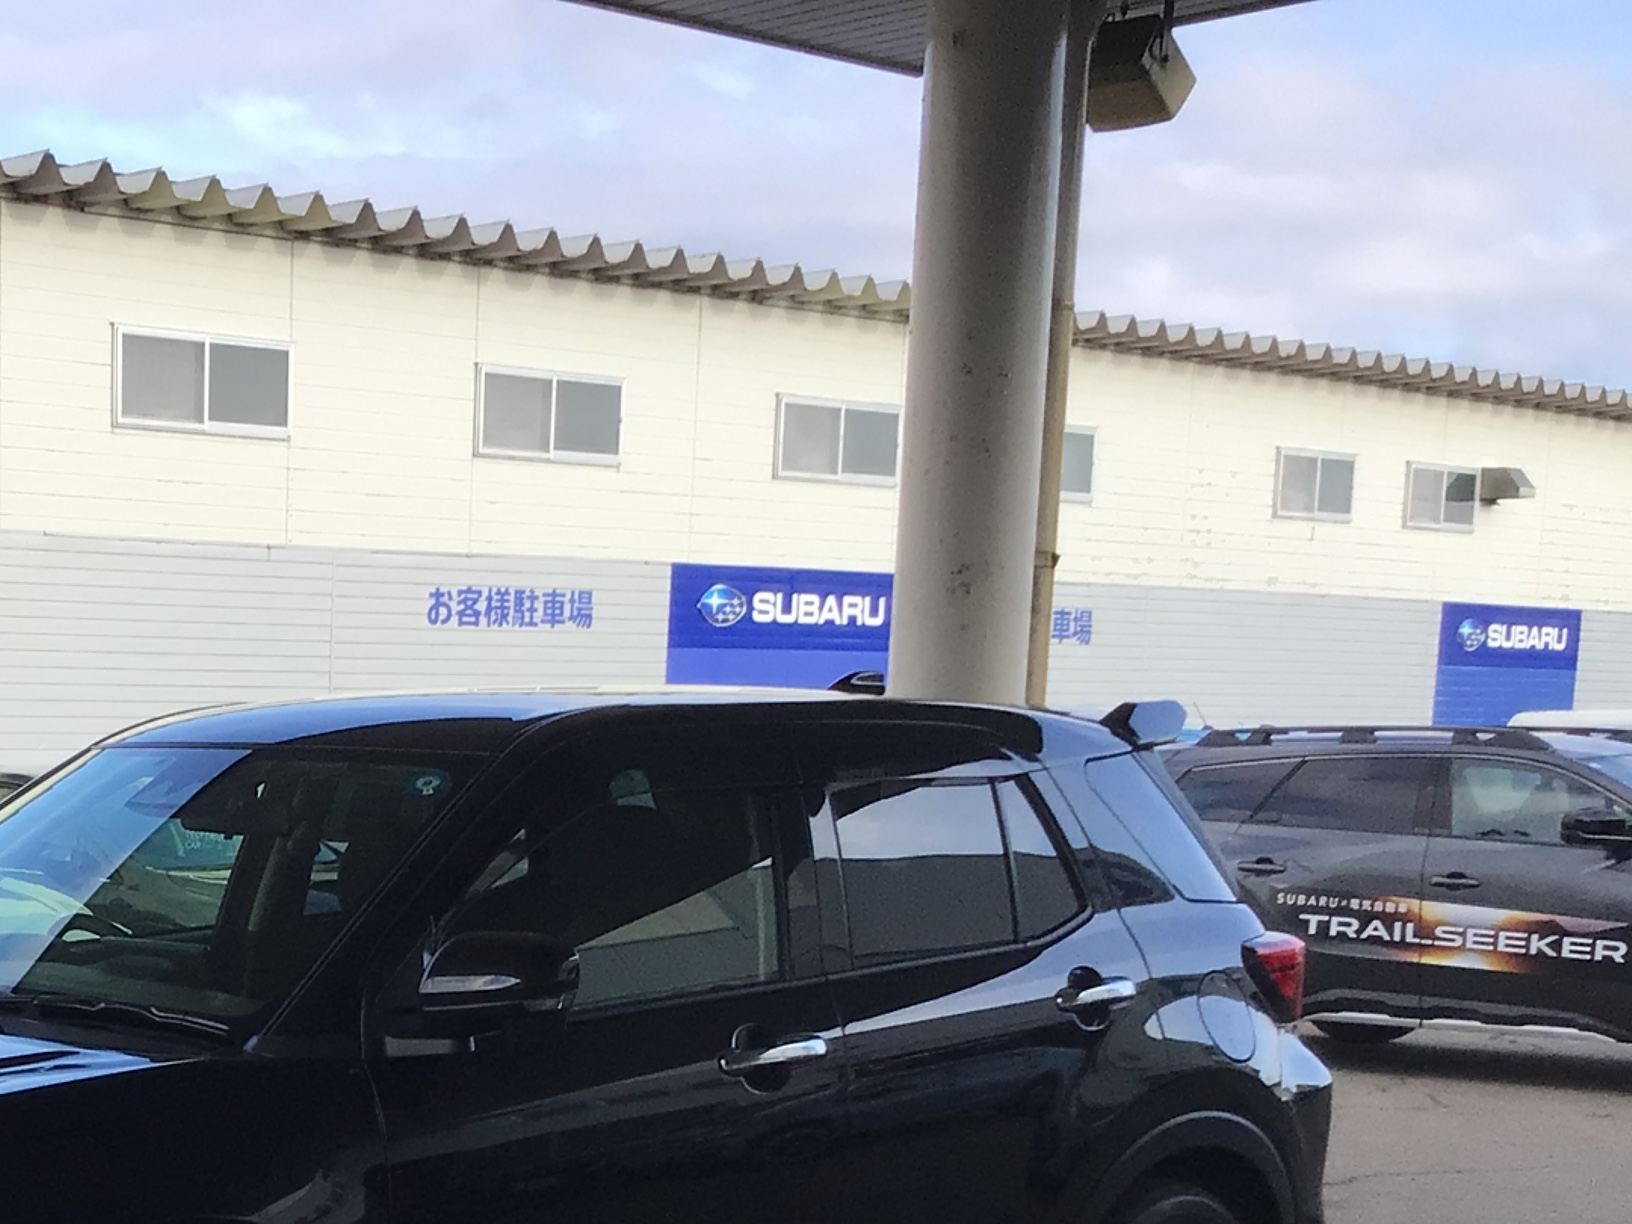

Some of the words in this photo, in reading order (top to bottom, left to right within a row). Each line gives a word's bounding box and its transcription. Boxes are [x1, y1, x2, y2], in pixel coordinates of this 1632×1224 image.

[427, 586, 594, 629] お客様駐車場
[752, 591, 886, 627] SUBARU
[1051, 608, 1093, 645] 車場
[1487, 623, 1568, 651] SUBARU
[1276, 892, 1339, 908] SUBARU
[1298, 913, 1628, 963] TRAILSEEKER
